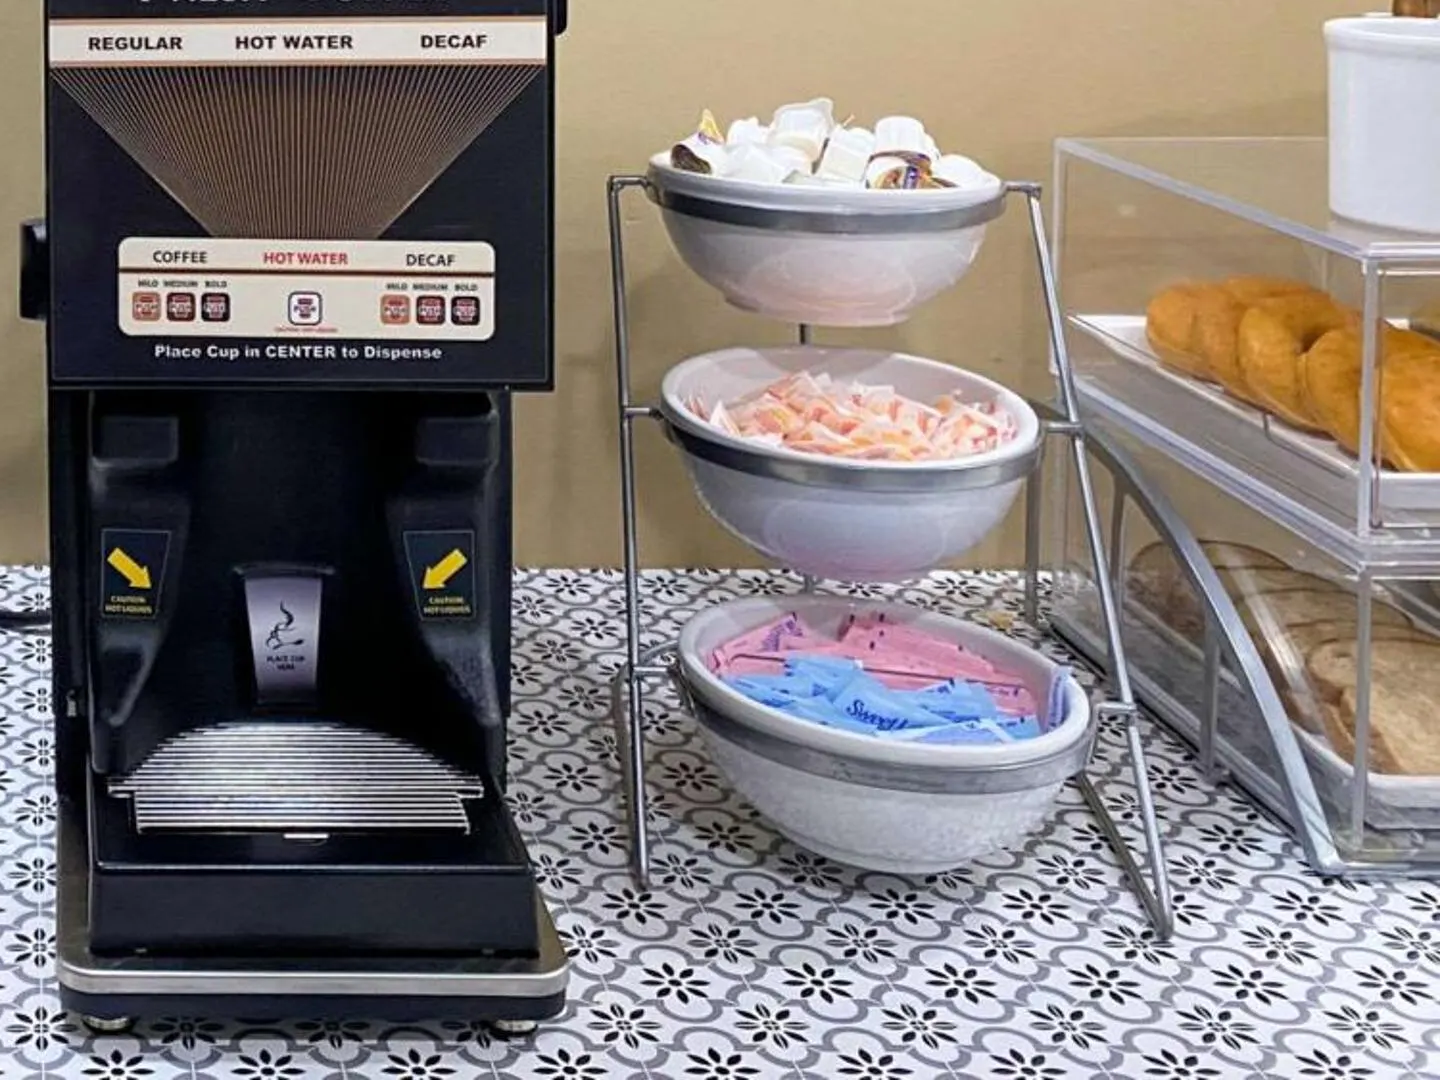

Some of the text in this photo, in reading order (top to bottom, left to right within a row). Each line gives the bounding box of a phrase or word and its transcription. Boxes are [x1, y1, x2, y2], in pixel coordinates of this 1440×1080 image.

[87, 35, 184, 52] REGULAR
[234, 33, 354, 51] HOT WATER
[420, 33, 489, 50] DECAF
[152, 250, 209, 265] COFFEE
[263, 251, 349, 267] HOT WATER
[405, 253, 457, 268] DECAF
[154, 344, 442, 361] Place Cup in CENTER to Dispense
